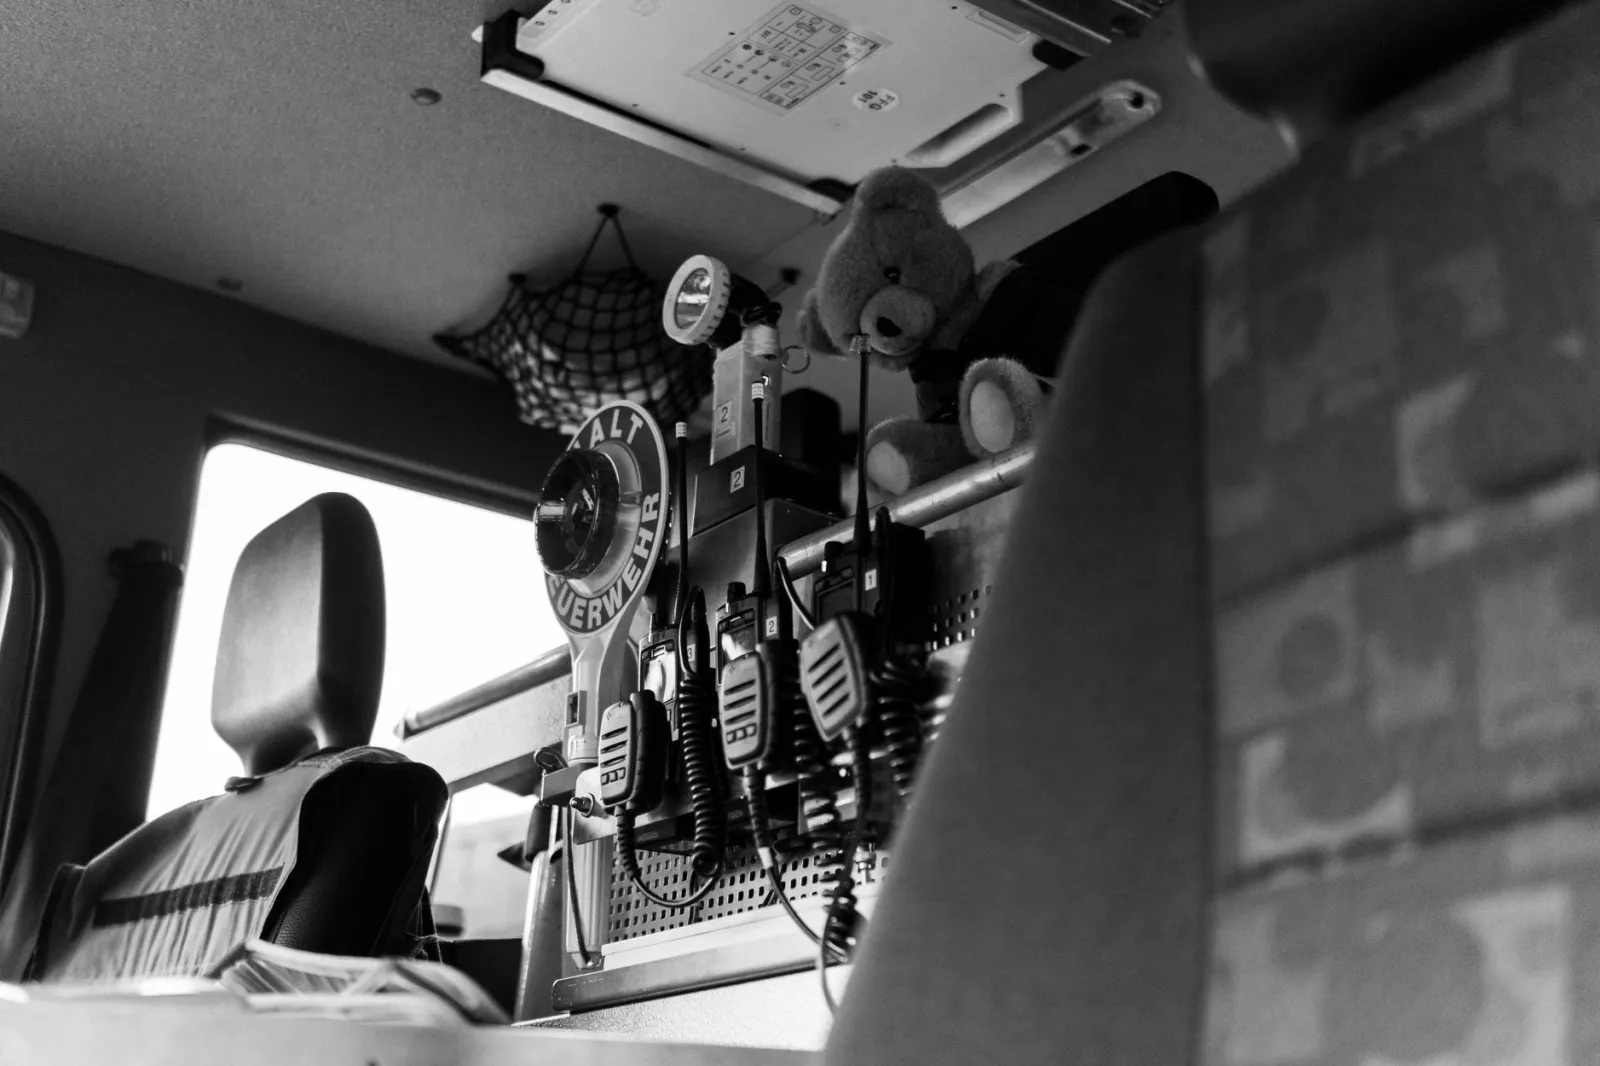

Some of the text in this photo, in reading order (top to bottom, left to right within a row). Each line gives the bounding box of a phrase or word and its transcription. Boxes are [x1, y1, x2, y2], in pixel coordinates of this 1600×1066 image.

[858, 90, 878, 103] 101
[721, 406, 728, 423] 2
[573, 408, 644, 449] ALT
[734, 471, 741, 488] 2
[548, 492, 660, 629] EUERWEHR
[769, 620, 775, 633] 2
